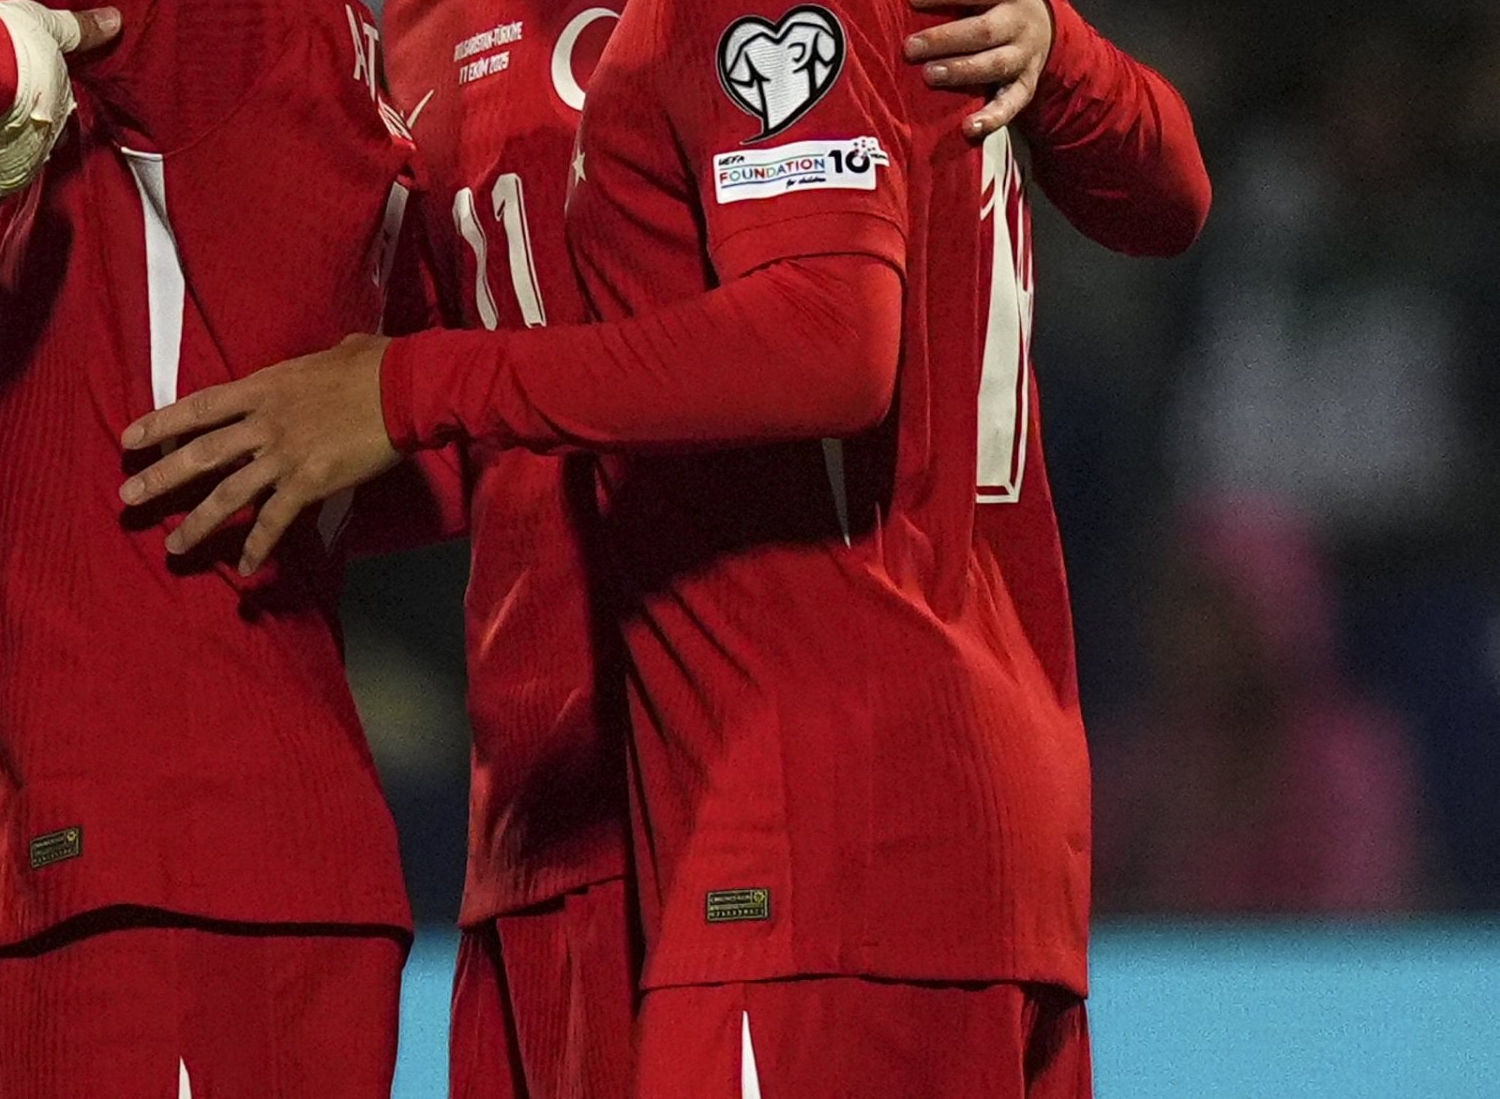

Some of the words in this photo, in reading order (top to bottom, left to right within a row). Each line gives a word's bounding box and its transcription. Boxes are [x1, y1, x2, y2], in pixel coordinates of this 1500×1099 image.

[718, 155, 745, 166] UEFA
[719, 159, 825, 185] FOUNDATION
[828, 149, 871, 174] 10
[452, 173, 547, 331] 11
